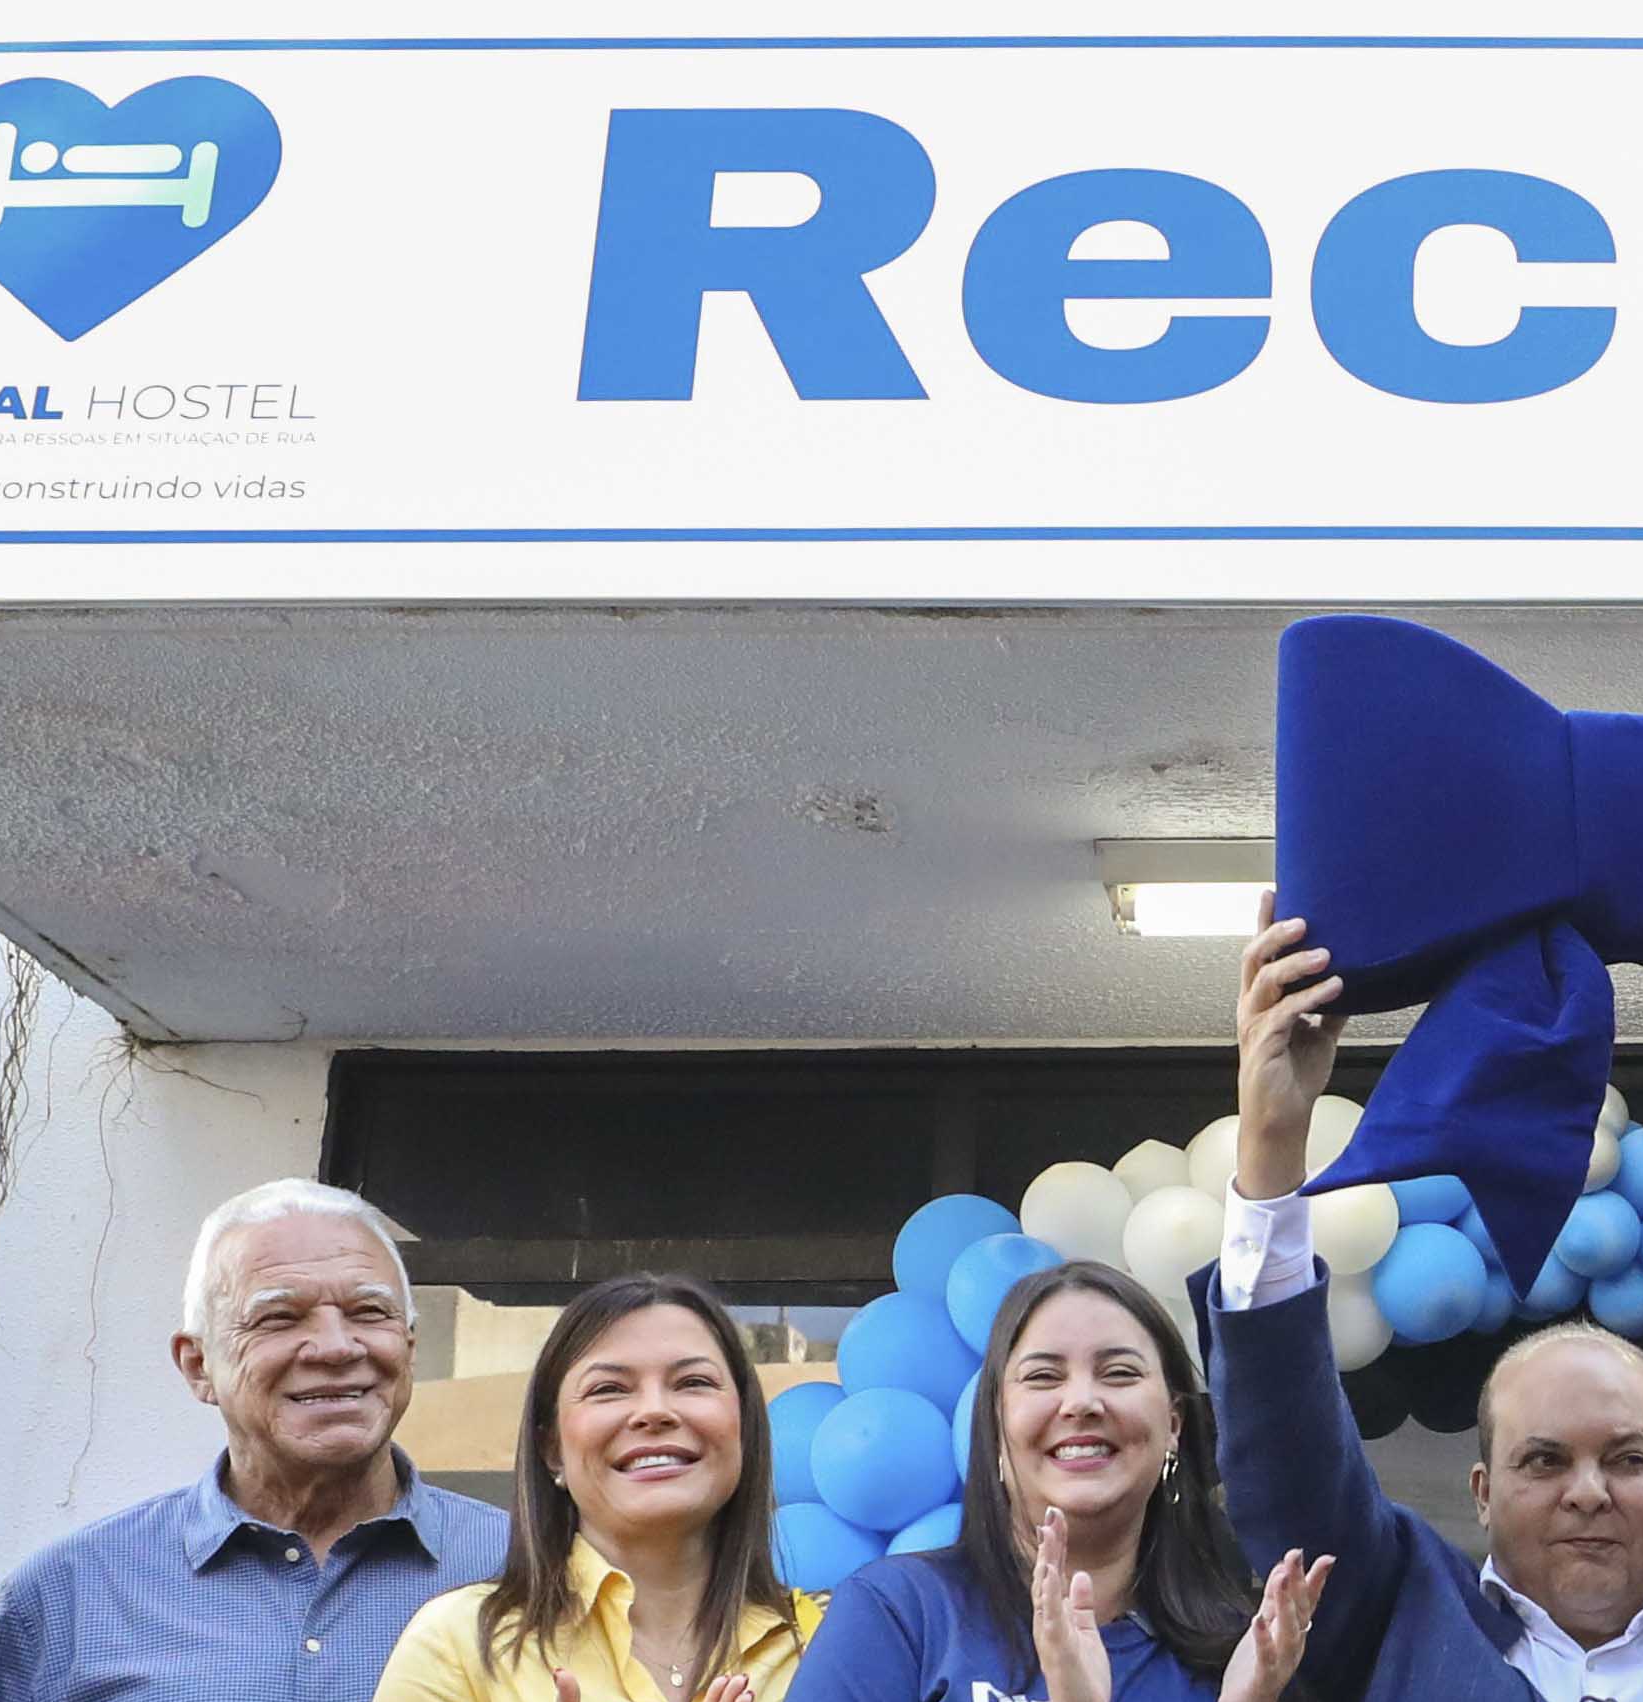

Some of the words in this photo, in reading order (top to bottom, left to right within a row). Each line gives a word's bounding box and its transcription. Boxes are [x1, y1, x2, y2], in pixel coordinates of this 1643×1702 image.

[86, 383, 317, 420] HOSTEL
[22, 431, 108, 447] PESSOAS
[112, 431, 142, 447] EM
[245, 431, 271, 447] DE
[277, 431, 317, 447] RUA
[212, 474, 307, 500] vidas
